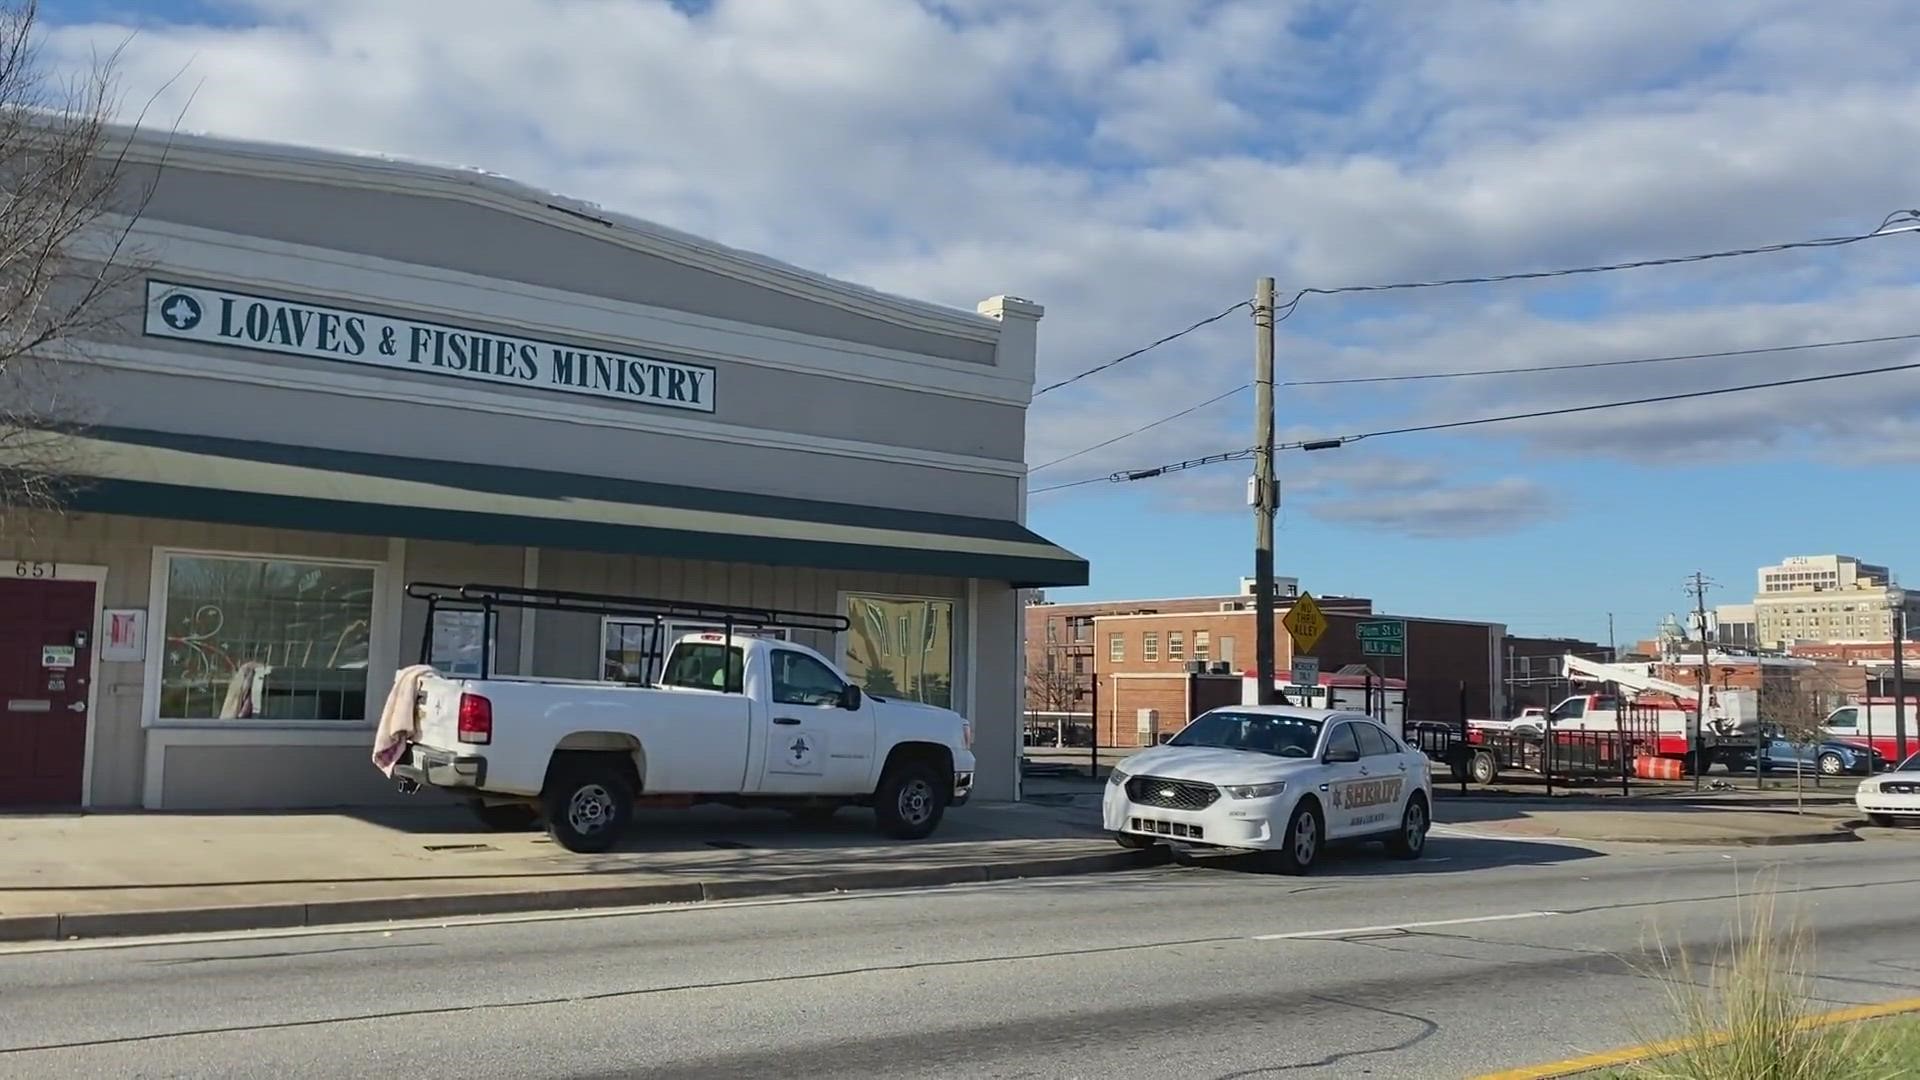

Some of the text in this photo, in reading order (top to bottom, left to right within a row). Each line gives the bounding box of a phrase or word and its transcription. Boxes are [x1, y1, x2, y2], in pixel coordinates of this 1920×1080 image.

[217, 298, 704, 404] LOAVES & FISHES MINISTRY
[16, 560, 56, 578] 651
[1301, 603, 1311, 613] NO
[1296, 612, 1316, 625] THRU
[1291, 624, 1318, 637] ALLEY
[1359, 625, 1379, 636] Plum
[1382, 624, 1391, 636] St
[1344, 779, 1402, 809] SHERIFF
